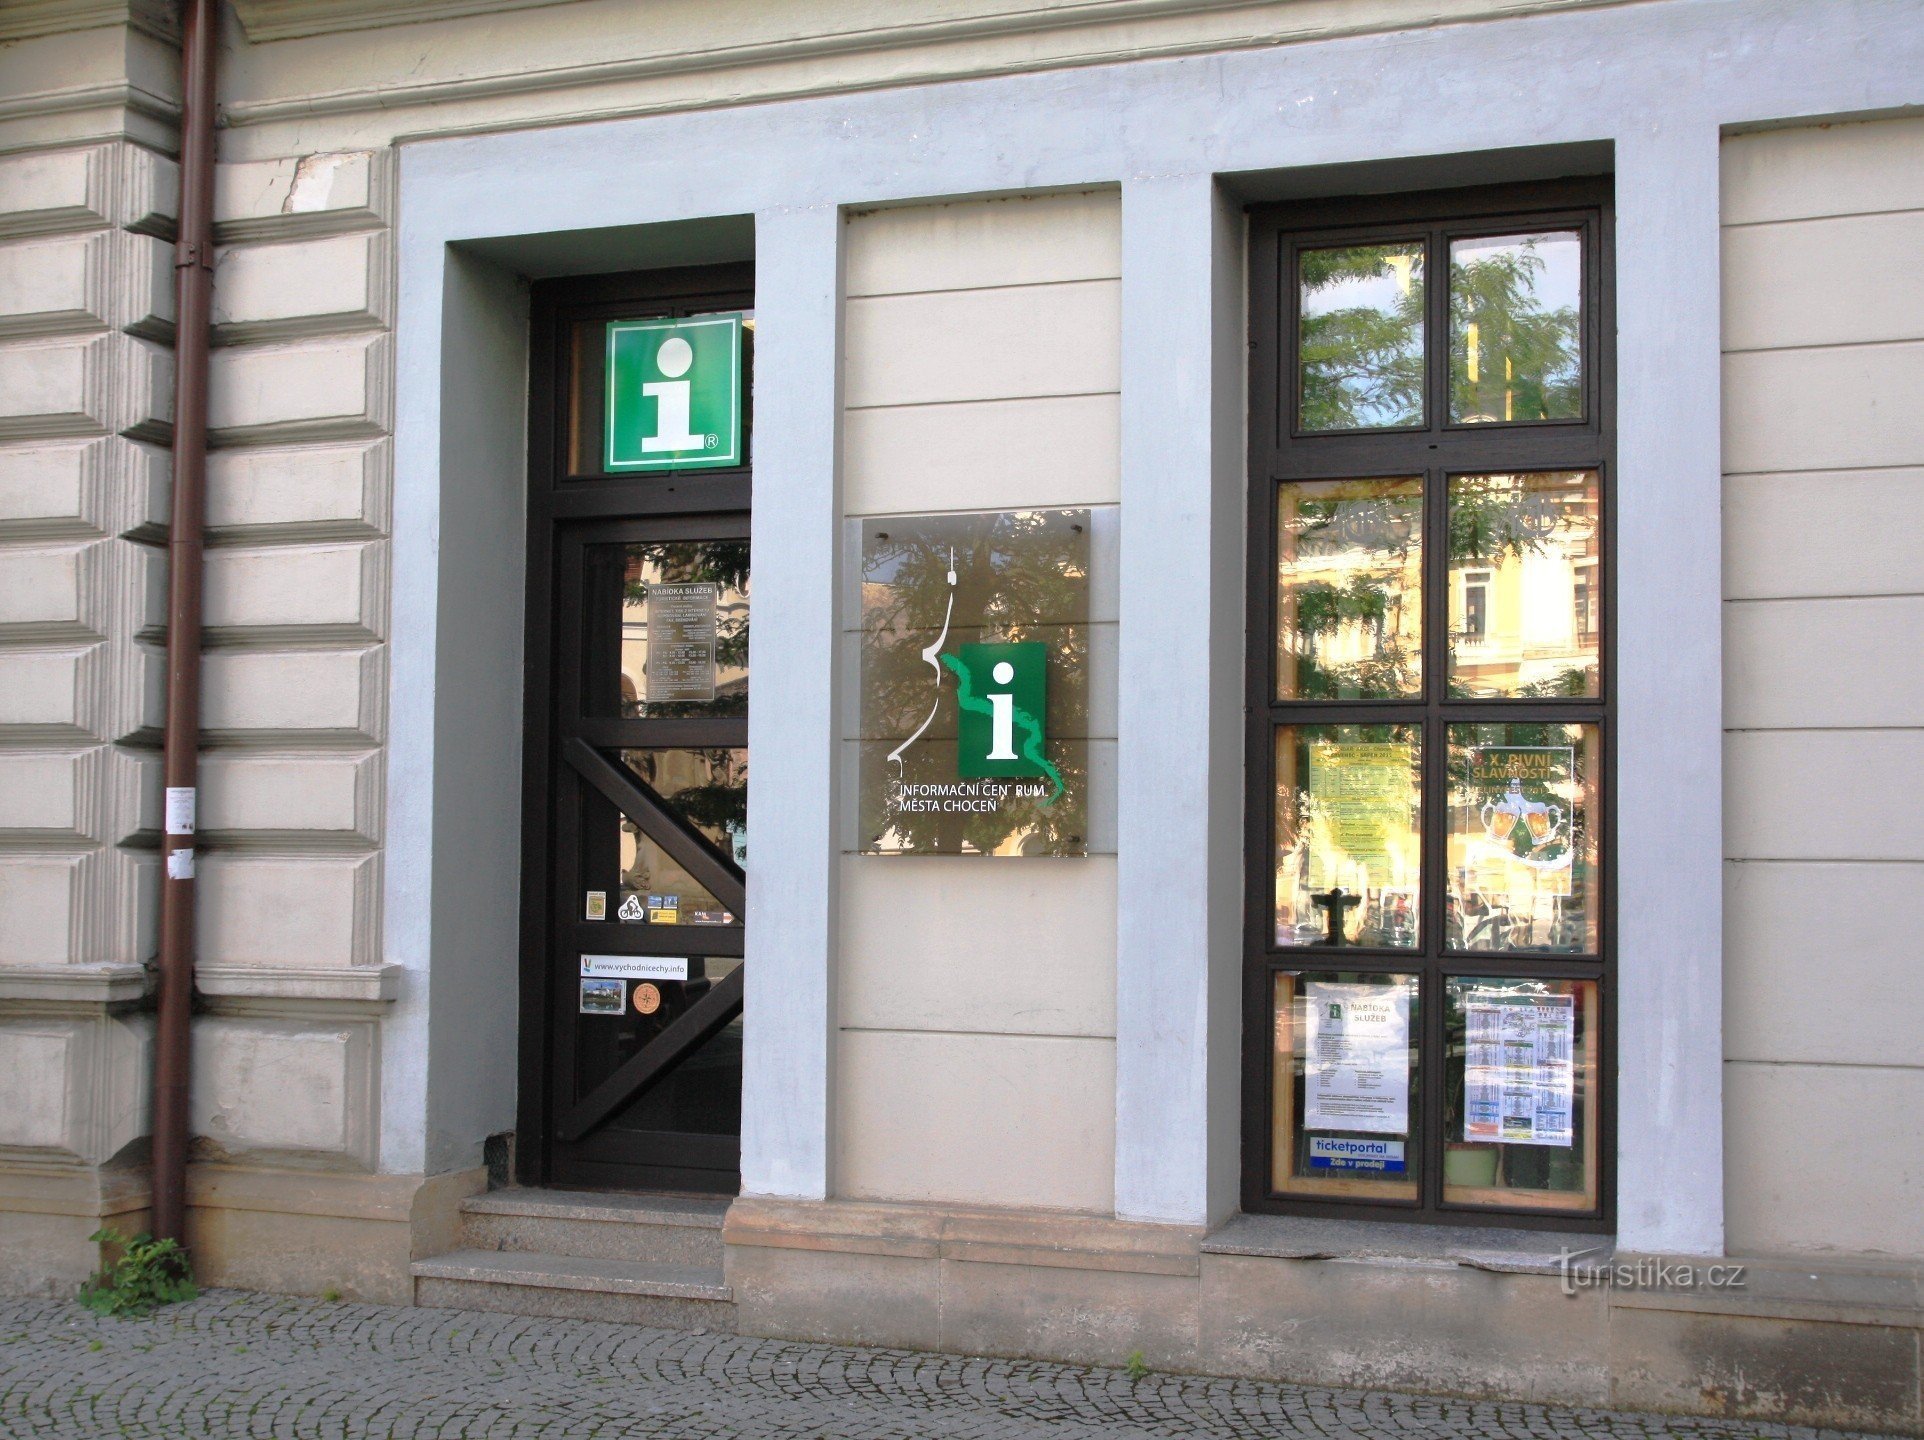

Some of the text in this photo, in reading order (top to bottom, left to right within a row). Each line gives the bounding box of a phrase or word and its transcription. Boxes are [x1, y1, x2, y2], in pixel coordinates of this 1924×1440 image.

[1508, 752, 1551, 767] PIVNÍ
[900, 782, 1045, 796] INFORMAČNÍ CENRUM
[900, 798, 997, 812] MĚSTA CHOCEŇ
[594, 963, 685, 974] www.vychodnicechy.info
[1354, 1012, 1387, 1022] SLUŽEB
[1316, 1140, 1387, 1154] ticketportal
